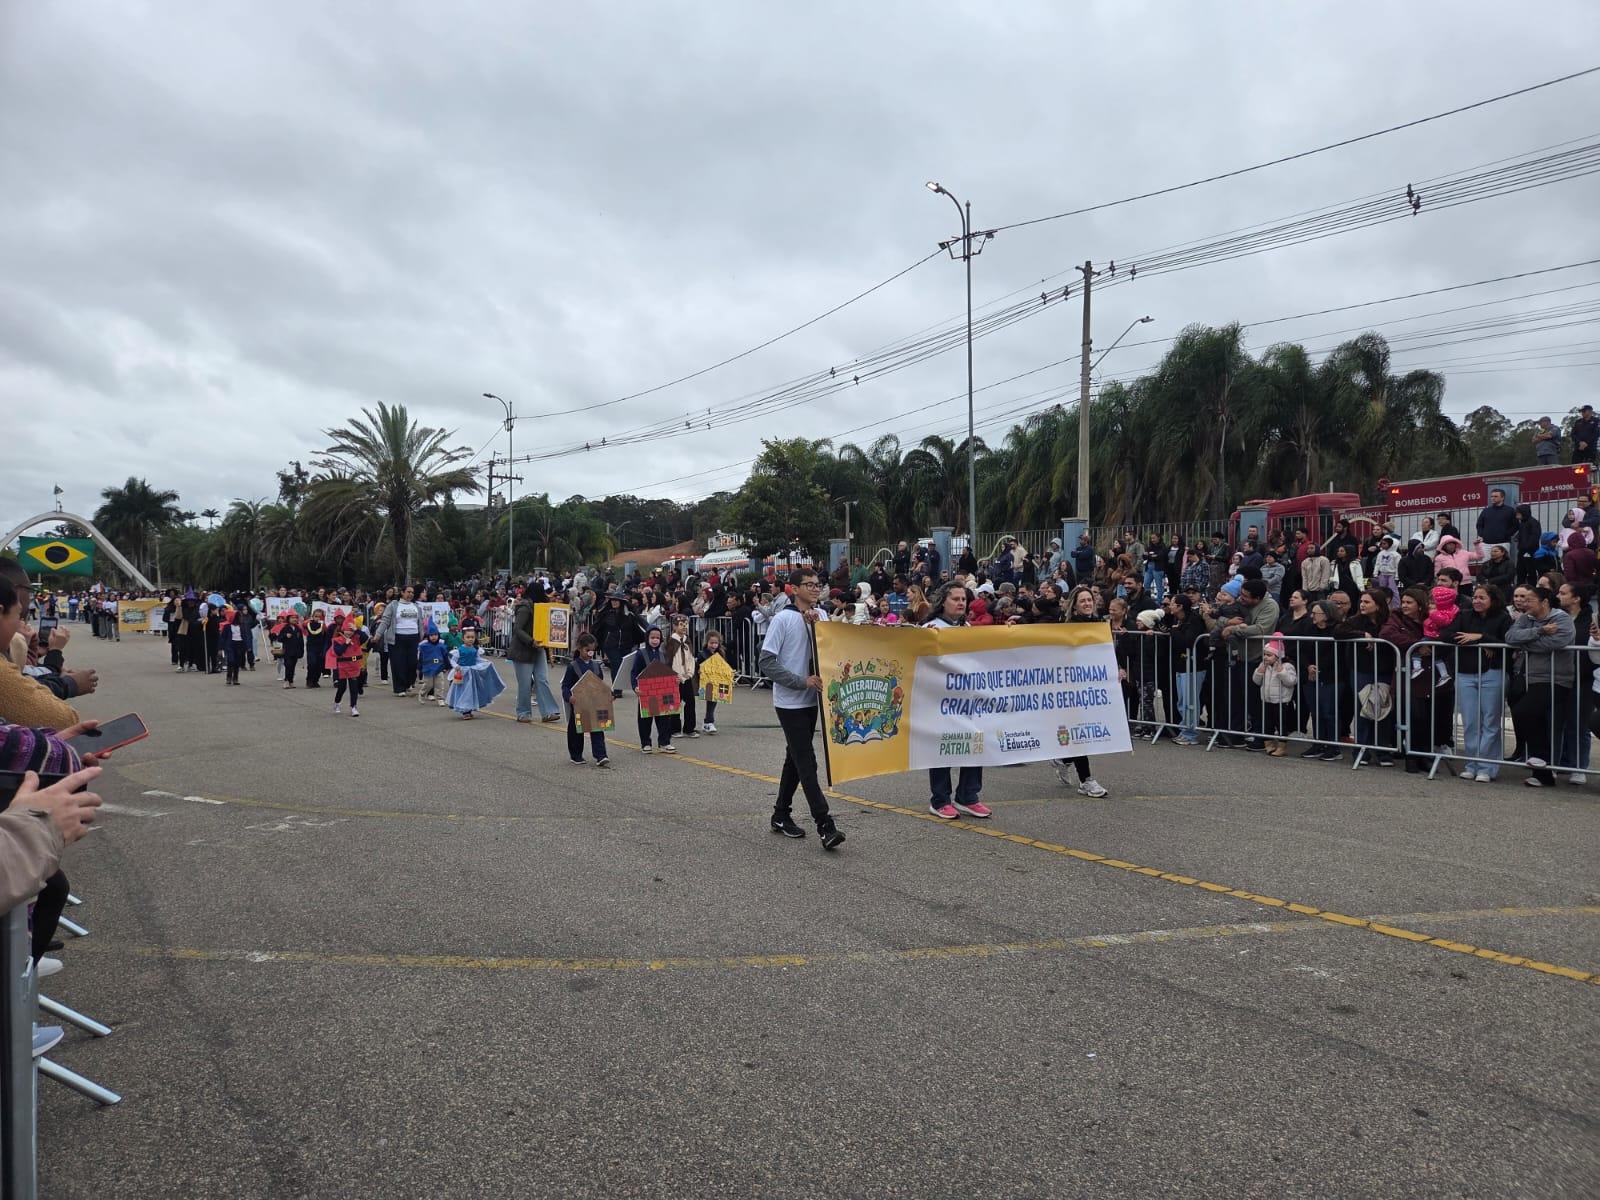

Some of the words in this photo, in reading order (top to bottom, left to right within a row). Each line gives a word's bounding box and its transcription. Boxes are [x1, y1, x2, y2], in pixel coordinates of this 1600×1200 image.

[1395, 496, 1447, 507] BOMBEIROS
[946, 672, 986, 690] CONTOS
[987, 670, 1003, 691] QUE
[1006, 668, 1054, 688] ENCANTAM
[1057, 667, 1062, 683] E
[1065, 665, 1108, 683] FORMAM
[840, 687, 845, 698] A
[846, 680, 888, 695] LITERATURA
[841, 692, 864, 709] INFANTO
[865, 691, 887, 703] JUVENIL
[941, 696, 995, 718] CRIANÇAS
[996, 695, 1009, 713] DE
[1011, 693, 1038, 712] TODAS
[1042, 691, 1054, 710] AS
[1057, 687, 1111, 710] GERAÇÕES.
[974, 732, 984, 742] 20
[1071, 725, 1111, 740] ITATIBA
[940, 741, 970, 755] PÁTRIA
[1007, 738, 1040, 751] Educação
